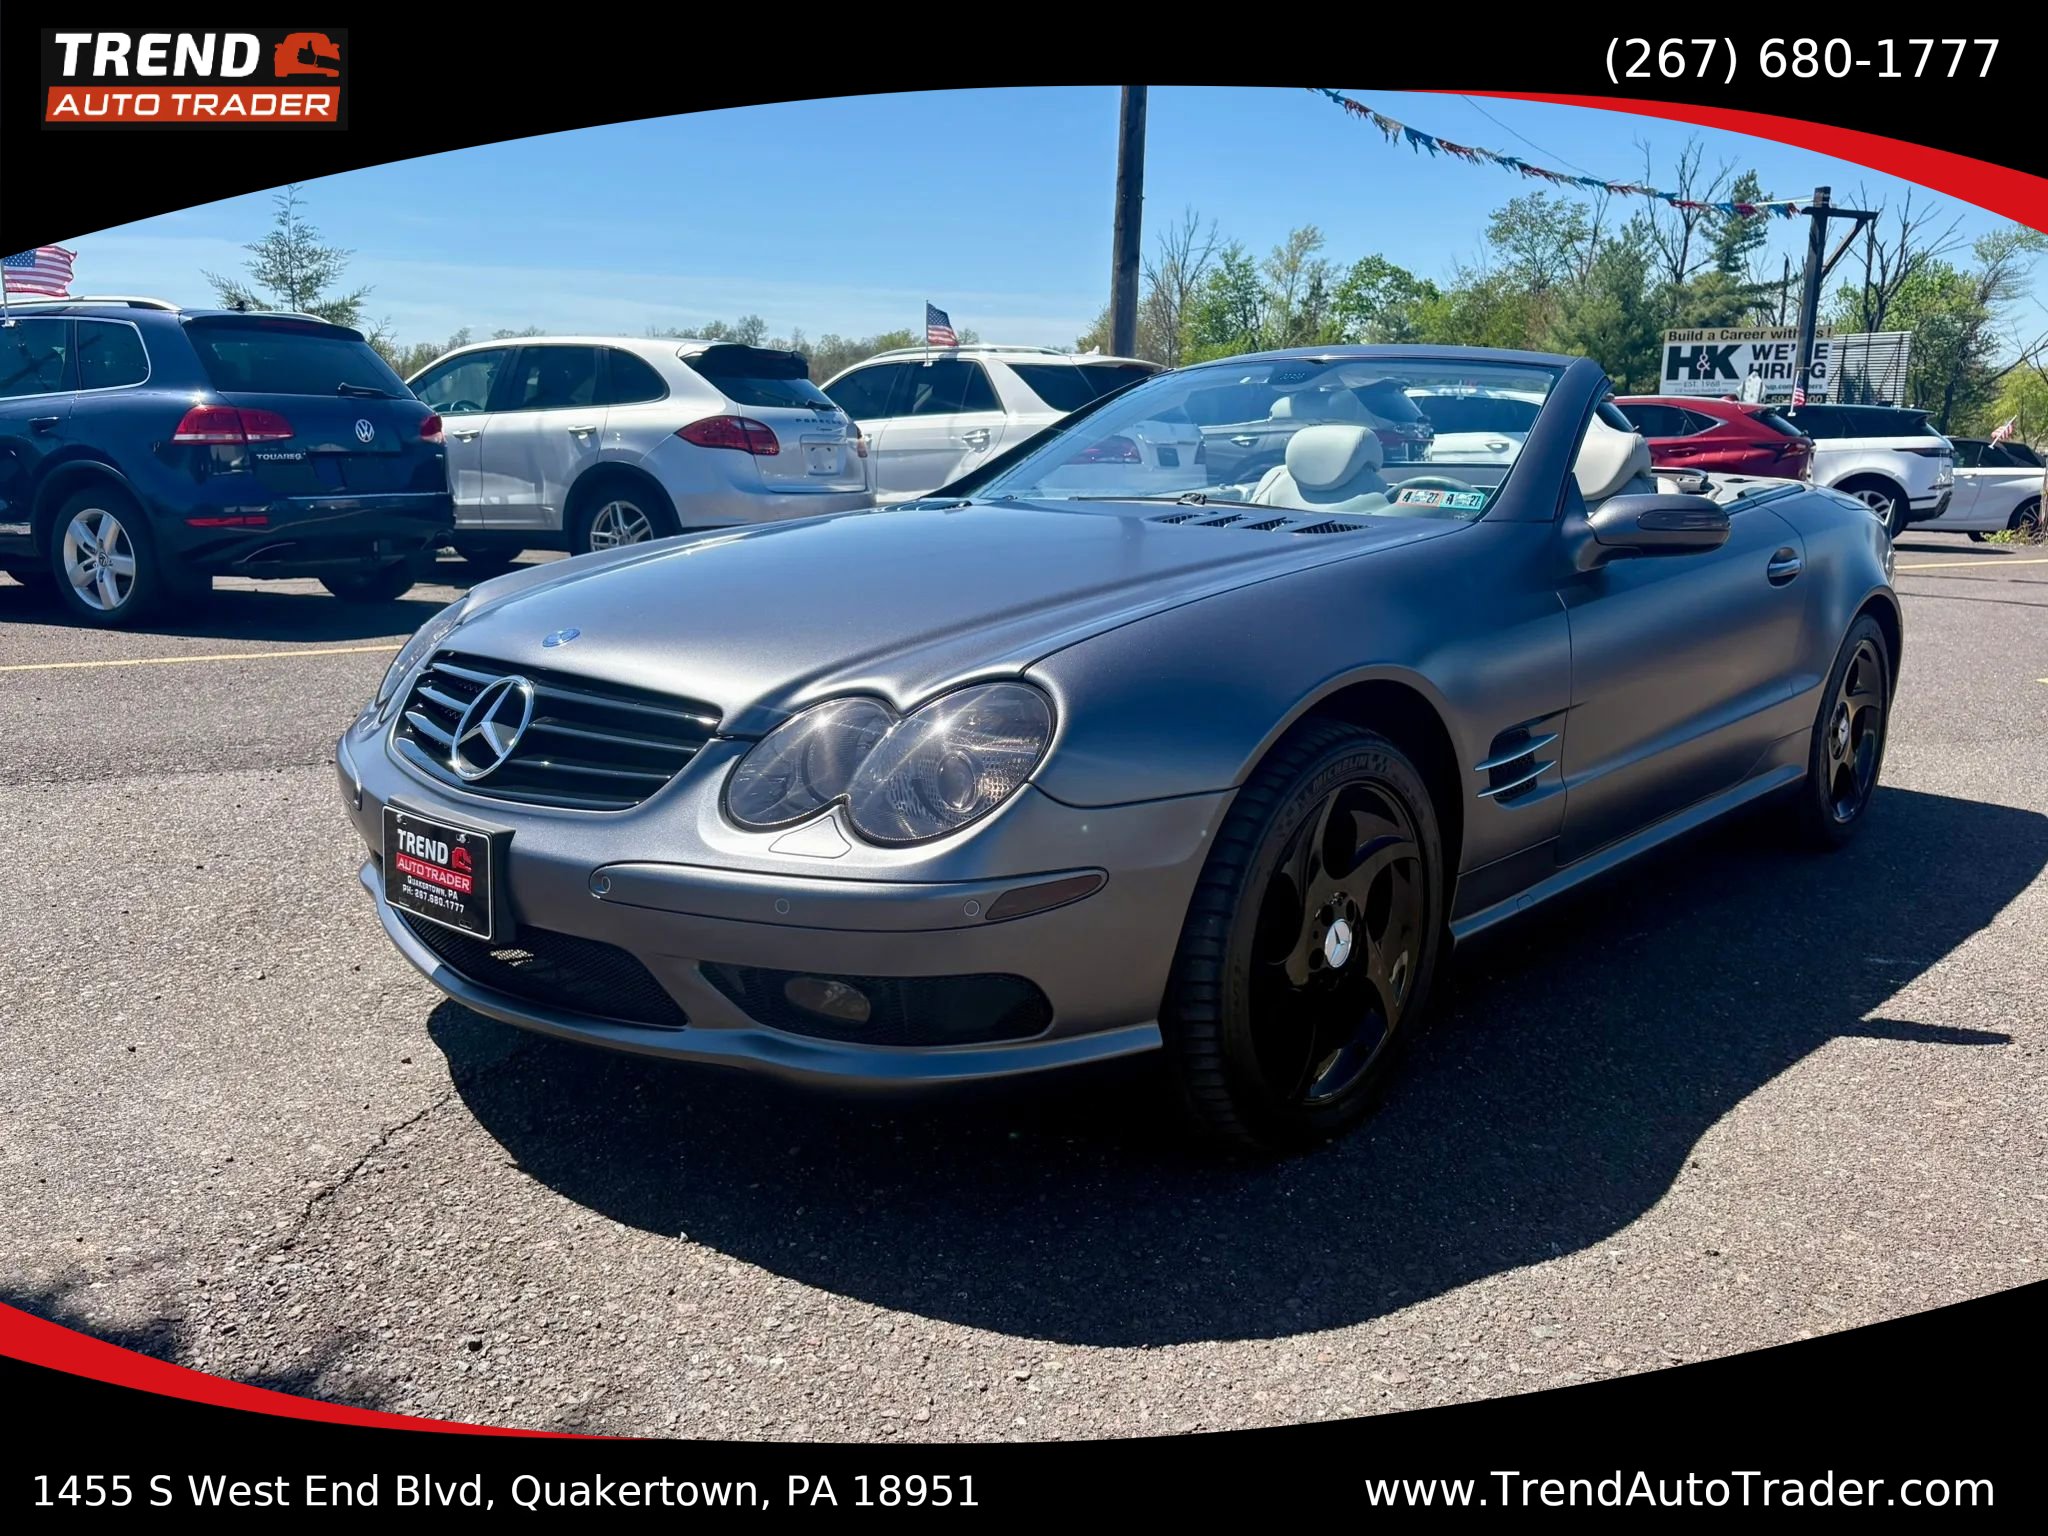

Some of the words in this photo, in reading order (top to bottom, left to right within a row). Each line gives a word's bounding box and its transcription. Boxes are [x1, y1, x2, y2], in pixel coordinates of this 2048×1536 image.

[1669, 330, 1703, 341] Build
[1707, 332, 1715, 340] a
[1720, 329, 1766, 340] Career
[1752, 343, 1829, 360] WE'E
[1666, 344, 1743, 380] H&K
[1748, 362, 1826, 379] HIRIG
[256, 452, 303, 460] TOUAREG
[1403, 491, 1412, 502] 4
[1427, 493, 1439, 504] 27
[1468, 495, 1480, 507] 27
[397, 829, 449, 865] TREND
[398, 858, 424, 876] AUTO
[425, 866, 470, 891] TRADER
[402, 884, 414, 896] PH:
[414, 888, 465, 913] 267.680.1777
[448, 889, 458, 900] PA
